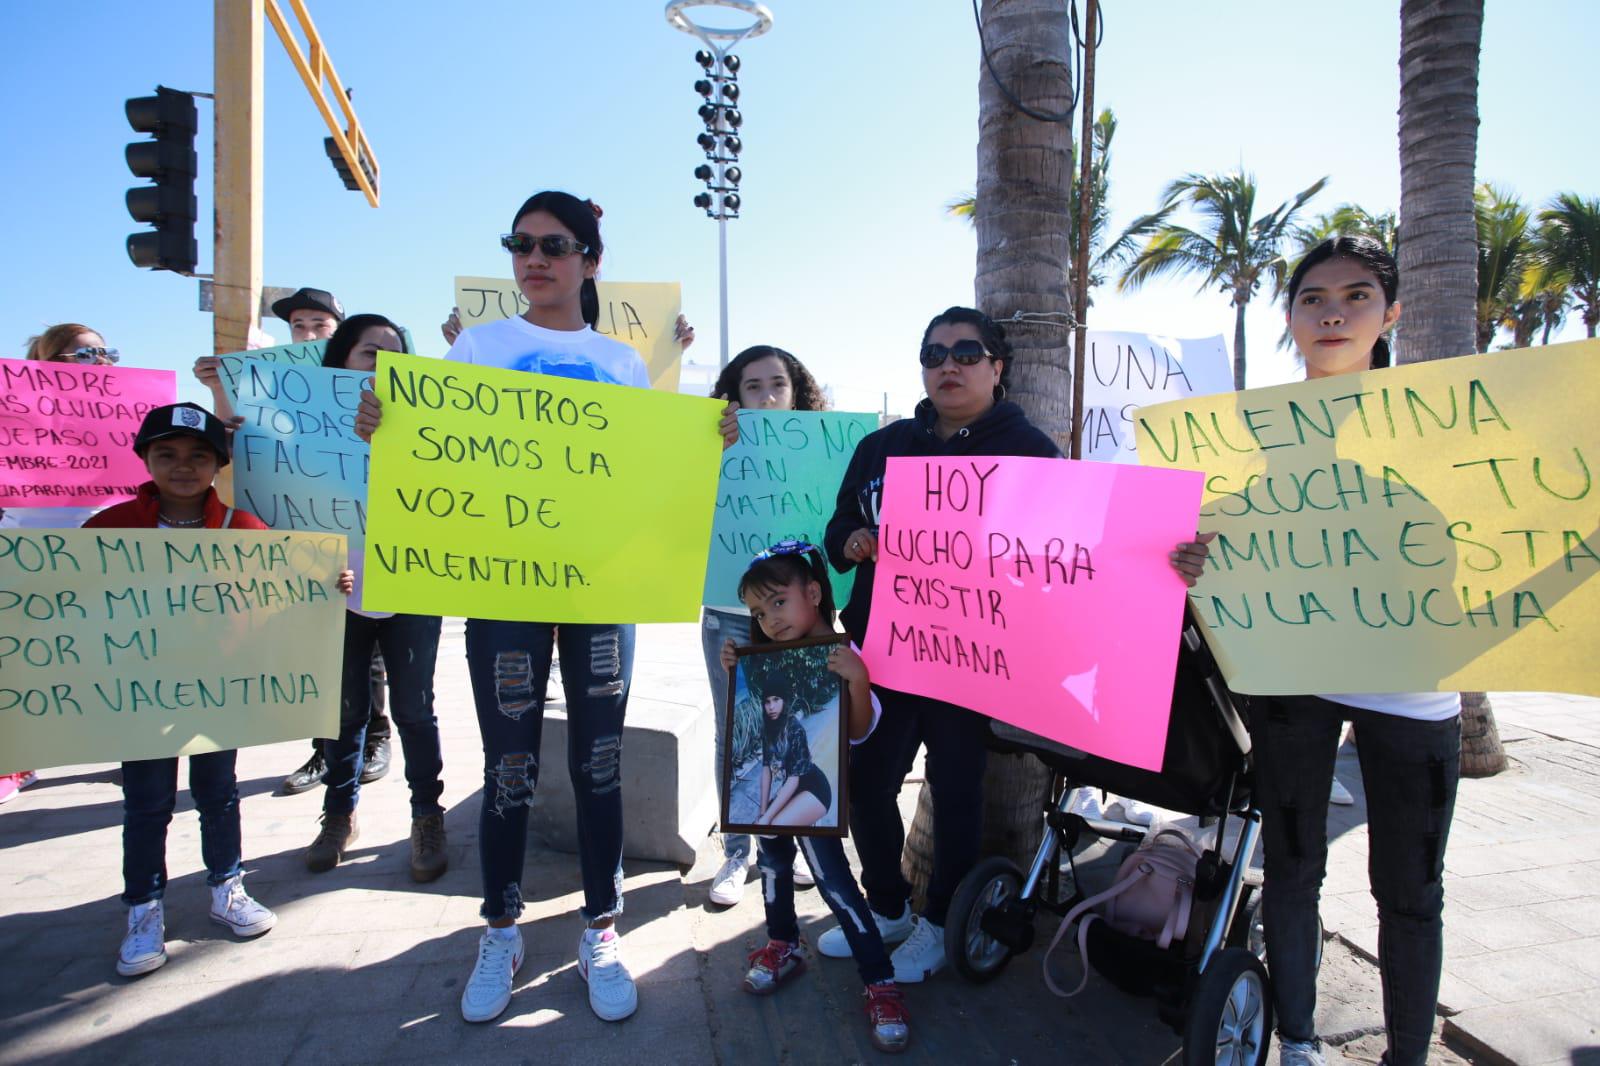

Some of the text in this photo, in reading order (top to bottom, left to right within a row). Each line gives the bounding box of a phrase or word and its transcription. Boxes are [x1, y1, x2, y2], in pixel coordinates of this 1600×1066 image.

[3, 364, 122, 397] MADRE
[251, 364, 311, 404] NO
[1091, 341, 1193, 392] UNA
[389, 366, 609, 431] NOSOTROS
[1139, 378, 1512, 464] VALENTINA
[34, 427, 99, 448] PASO
[243, 403, 366, 443] TODAS
[820, 417, 868, 460] NO
[412, 426, 612, 478] SOMOS LA
[719, 455, 788, 483] CAN
[925, 462, 999, 517] HOY
[1199, 446, 1592, 517] SCUCHA TU
[396, 487, 561, 529] VOZ DE
[96, 535, 145, 575] MI
[164, 535, 290, 574] MAMÁ
[374, 543, 592, 589] VALENTINA.
[885, 523, 1096, 586] LUCHO PARA
[1205, 520, 1600, 573] MILIA ESTA
[0, 575, 329, 621] POR MI HERMANA
[893, 573, 1007, 630] EXISTIR
[1266, 591, 1337, 626] LA
[0, 627, 158, 668] POR MI
[888, 620, 1011, 681] MAÑANA
[0, 672, 320, 716] POR VALENTINA
